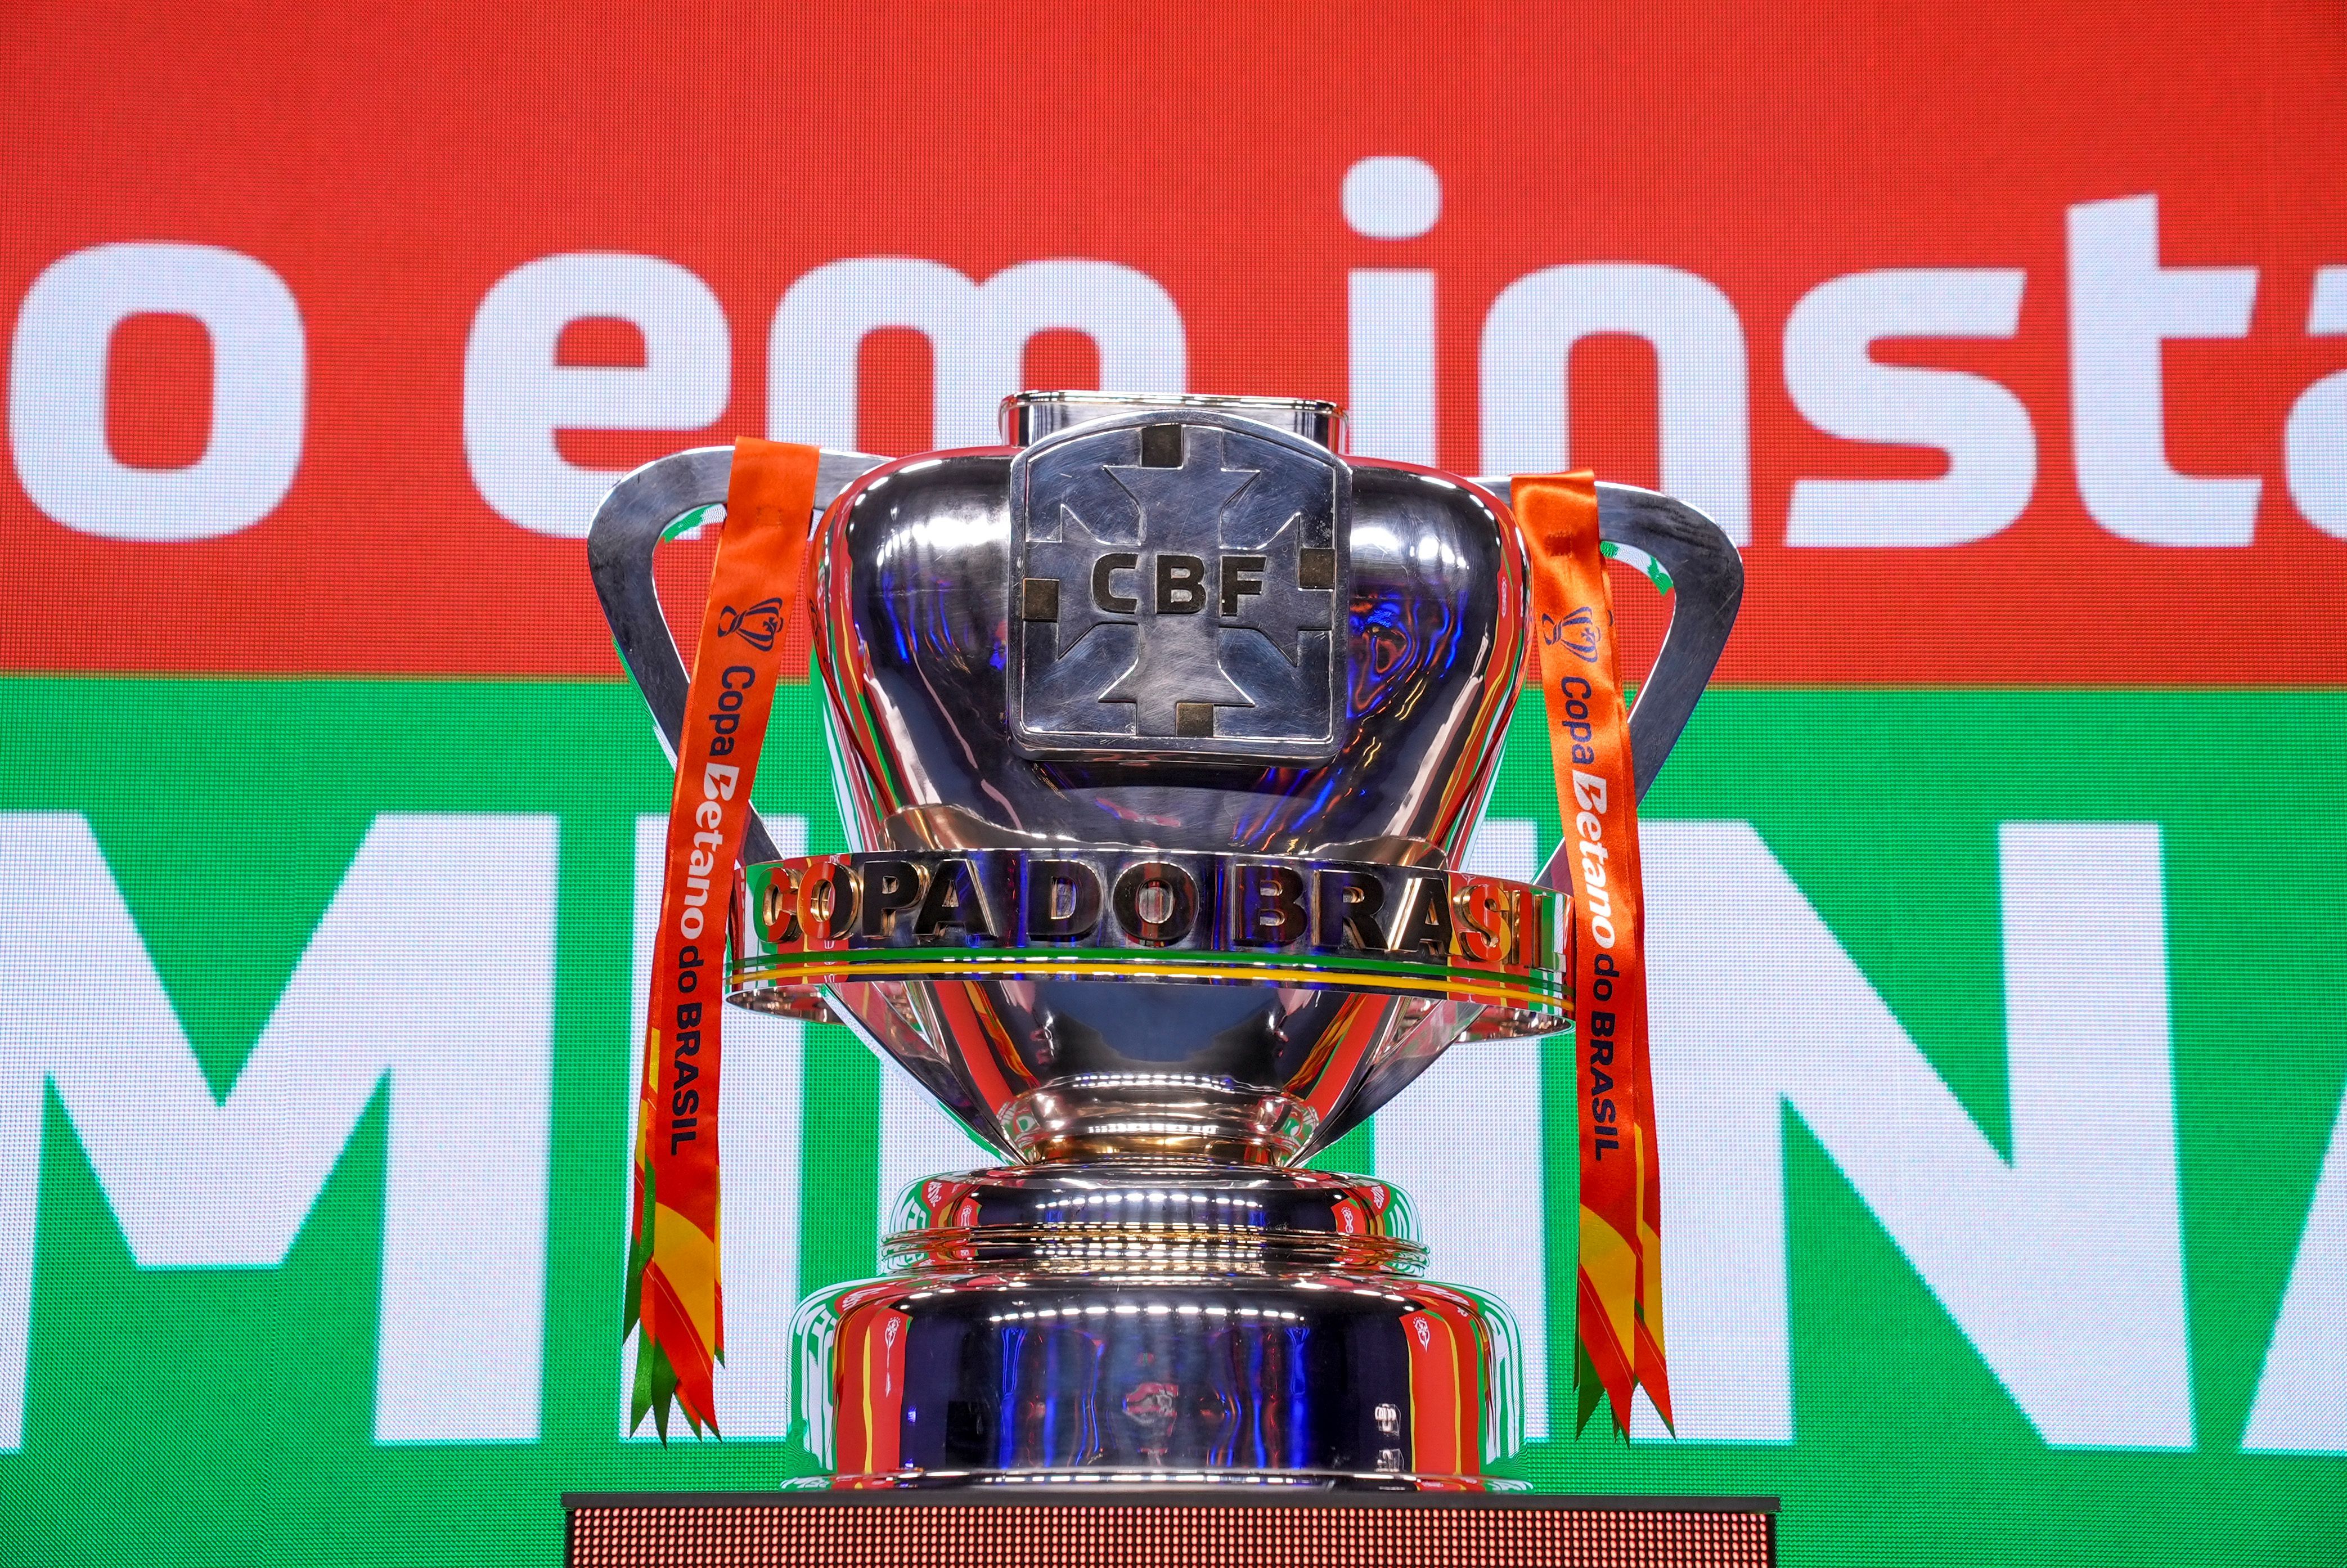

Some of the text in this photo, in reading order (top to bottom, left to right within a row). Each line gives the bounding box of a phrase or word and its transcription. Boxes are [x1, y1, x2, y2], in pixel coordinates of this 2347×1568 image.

[462, 252, 1188, 541] em
[1342, 156, 2347, 550] inst
[1091, 553, 1267, 617] CBF
[671, 665, 756, 1156] Copa Betano do BRASIL
[753, 858, 1567, 973] COPA DO BRASIL
[1561, 676, 1621, 1161] Copa Betano do BRASIL
